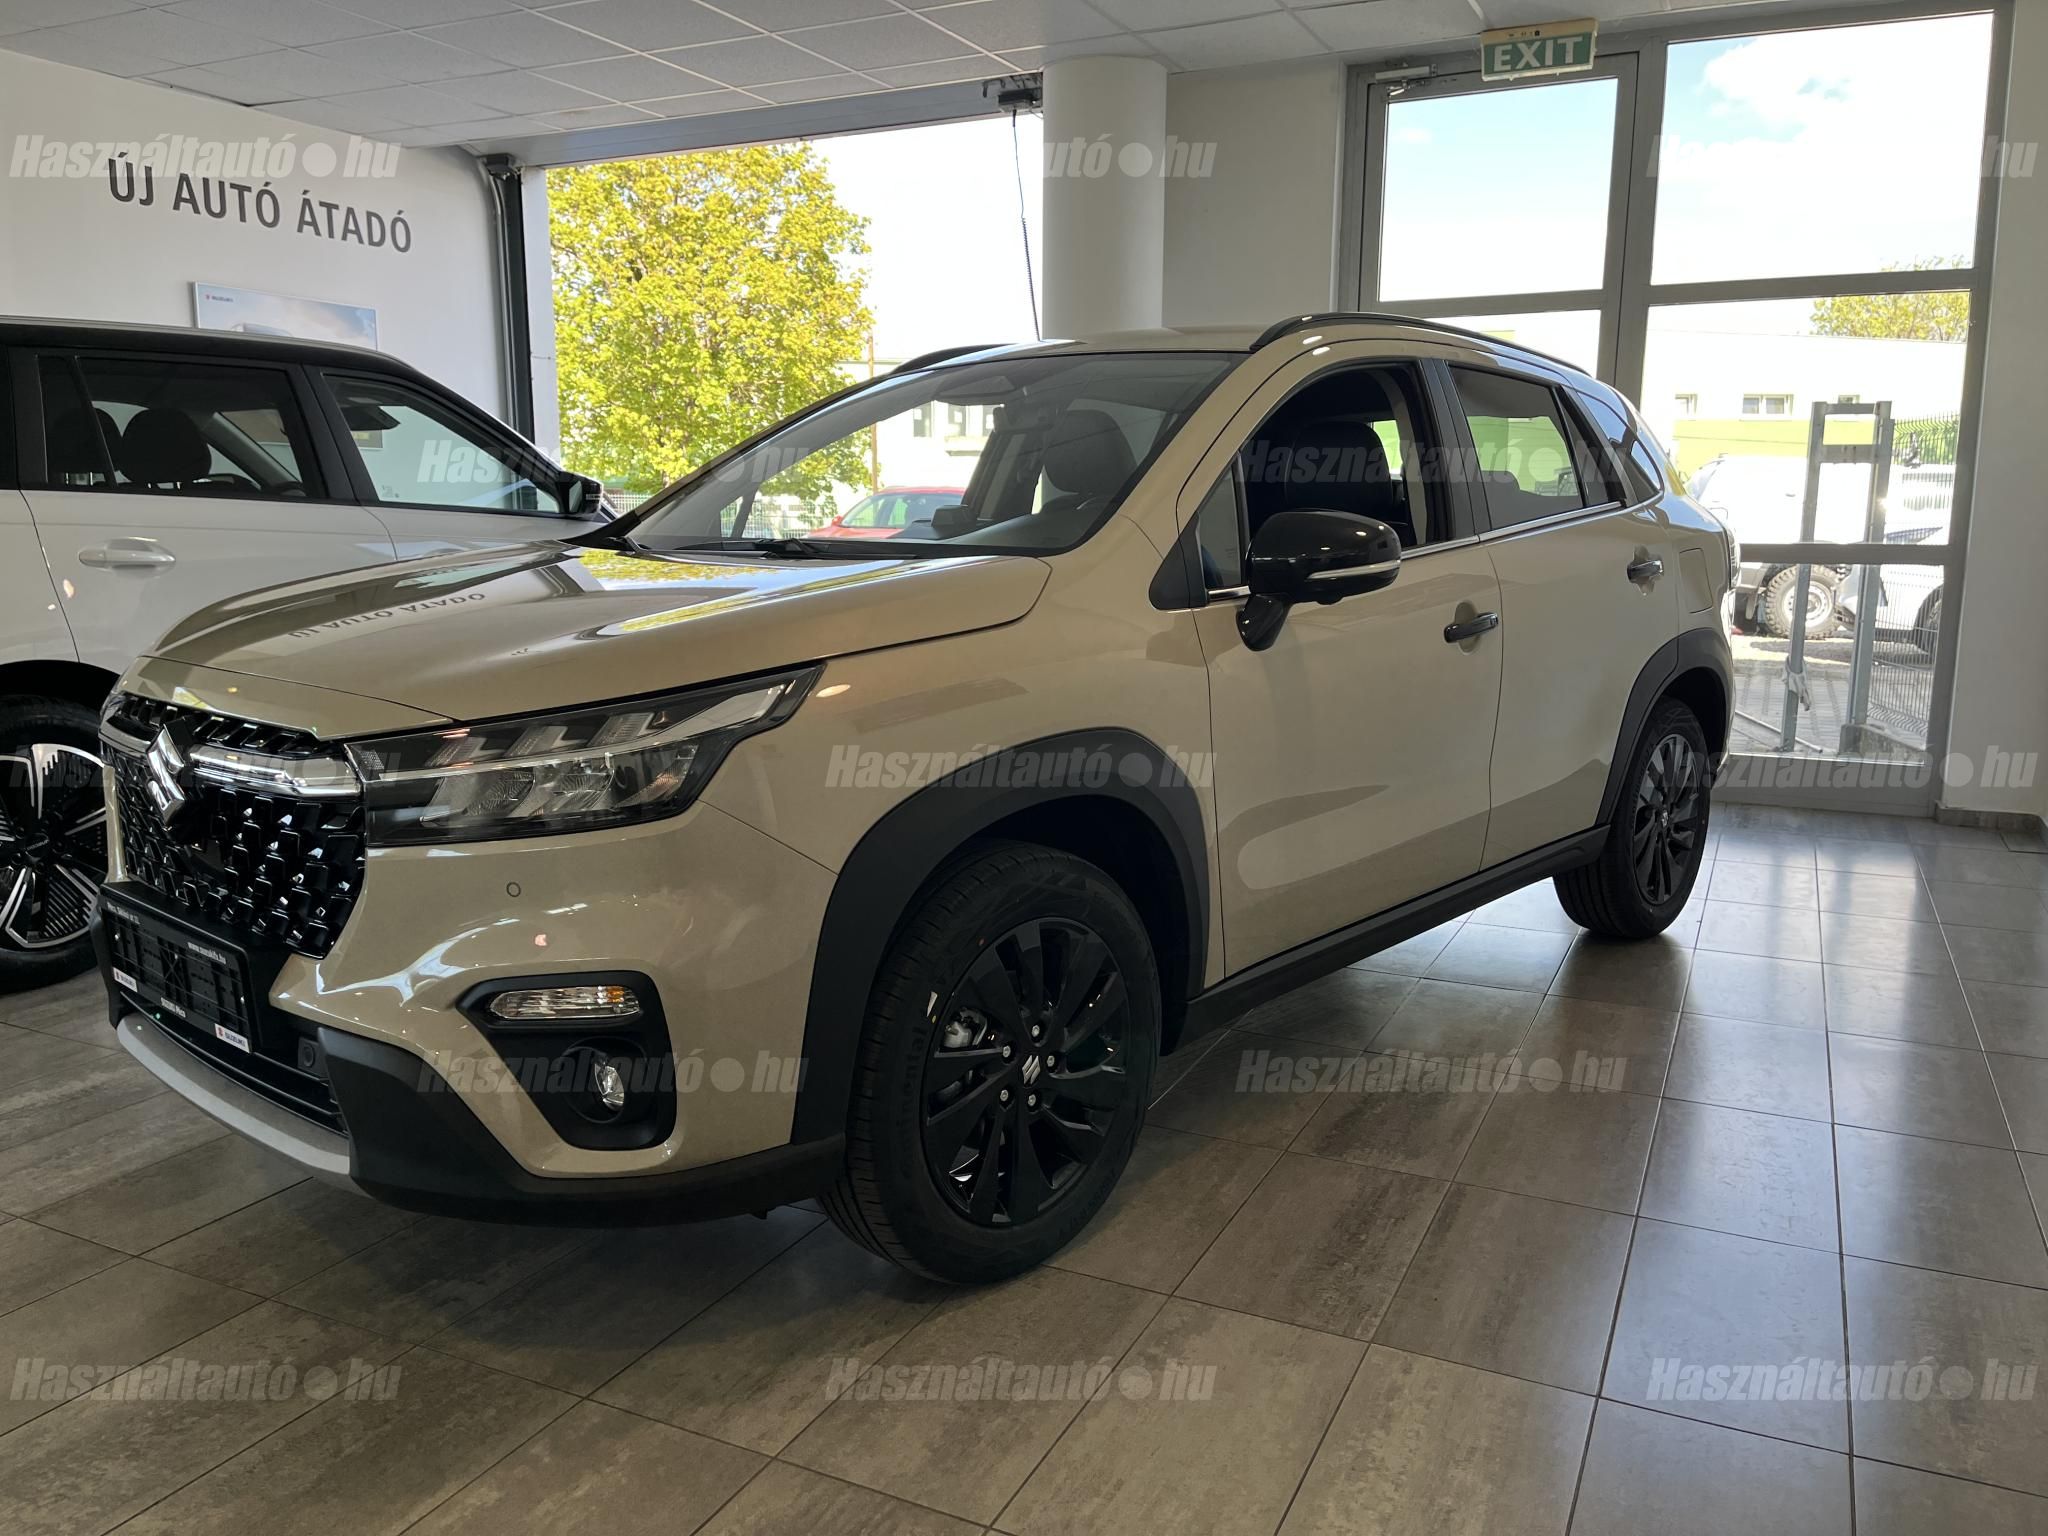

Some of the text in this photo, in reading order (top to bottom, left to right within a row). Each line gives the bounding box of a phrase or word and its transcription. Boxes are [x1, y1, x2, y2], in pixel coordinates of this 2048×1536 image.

[1493, 36, 1583, 72] EXIT
[108, 151, 412, 254] ÚJ AUTÓ ÁTADÓ
